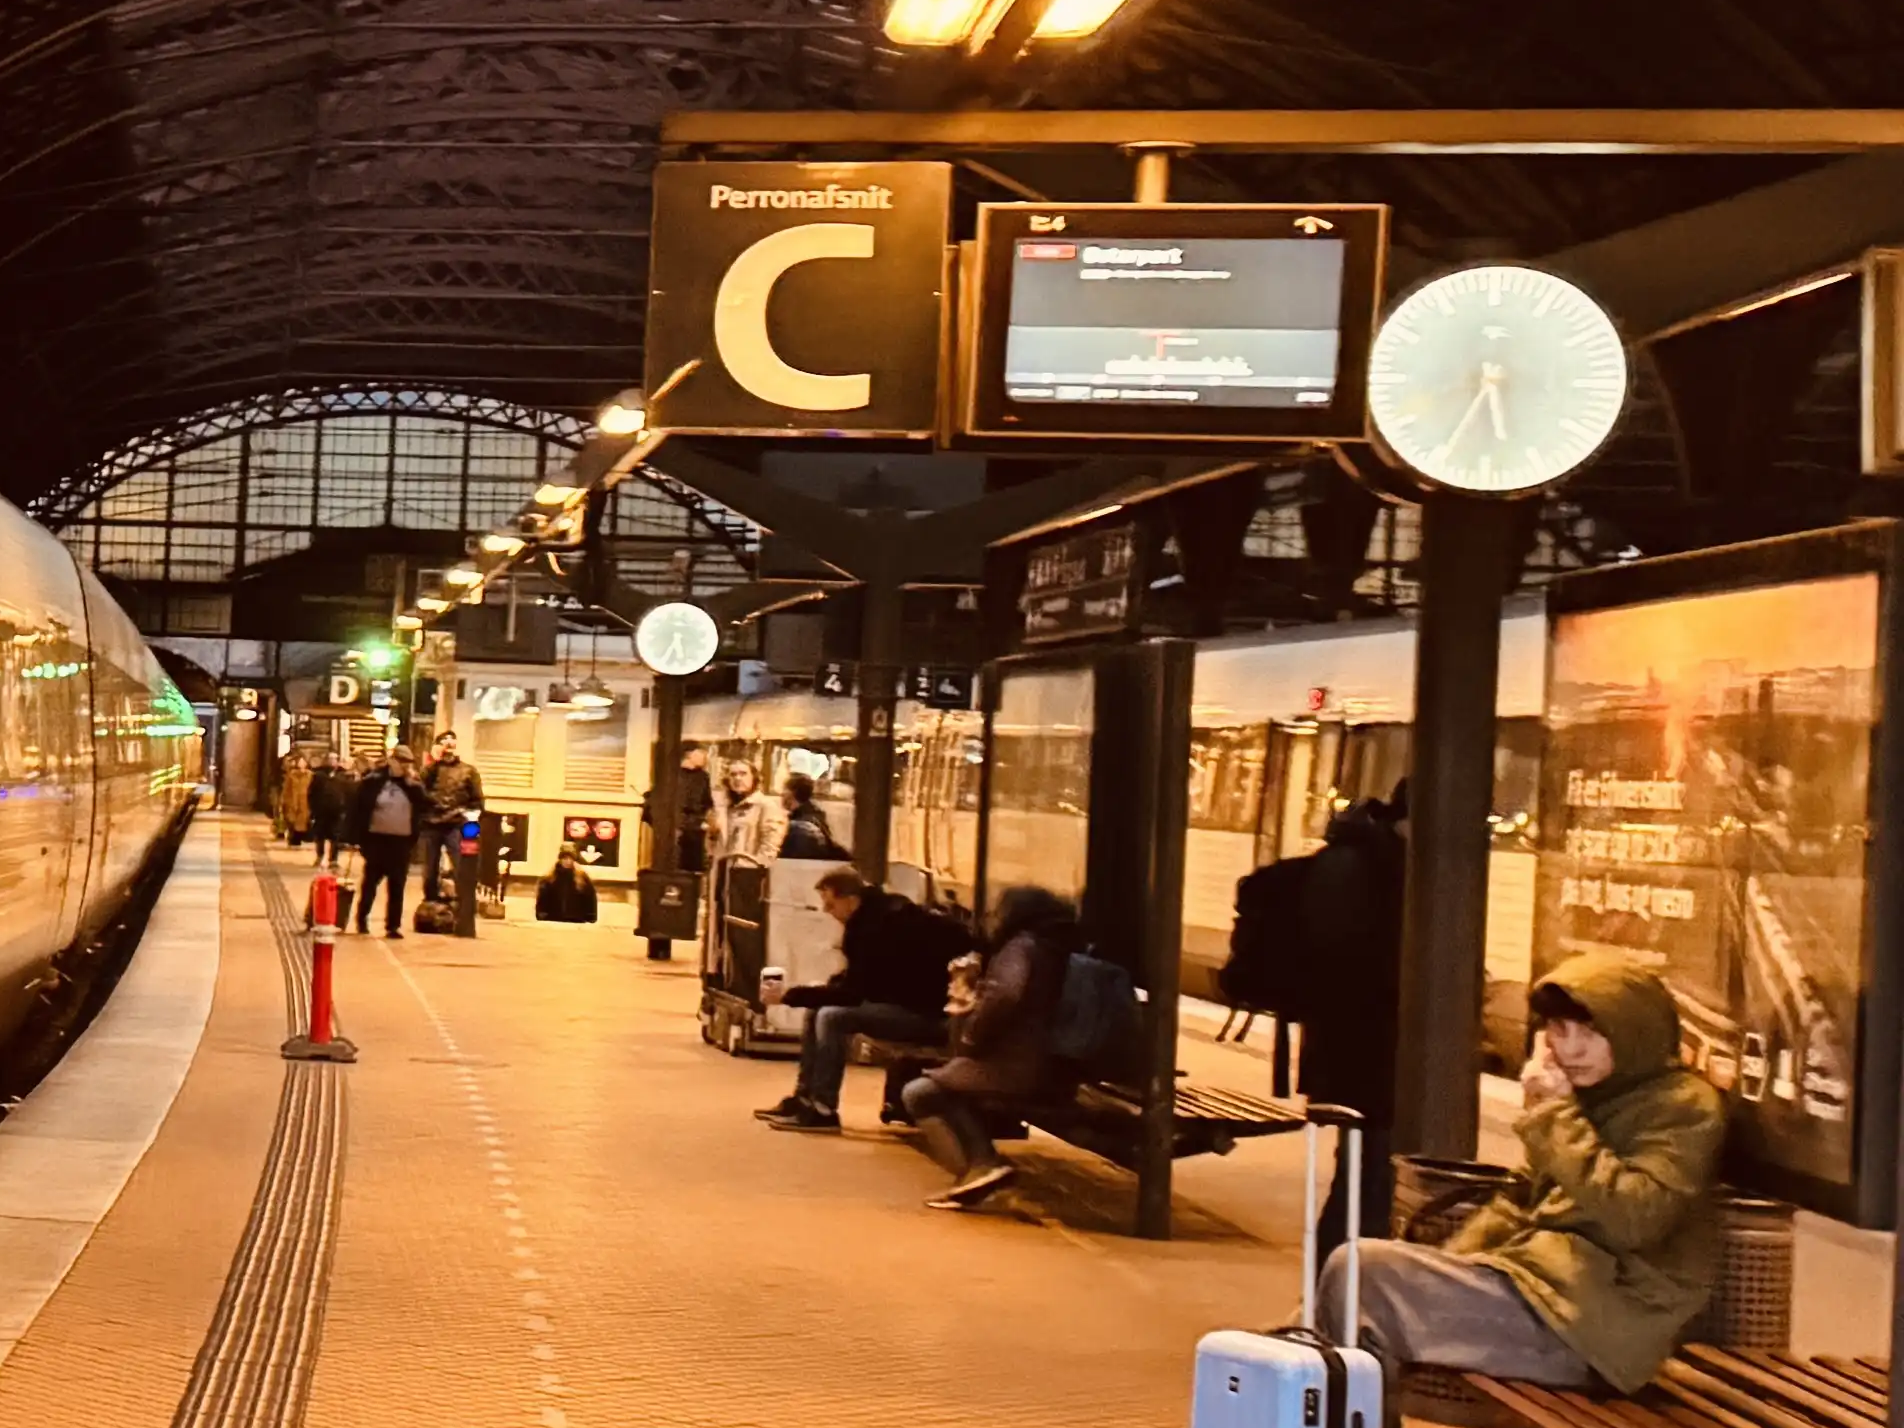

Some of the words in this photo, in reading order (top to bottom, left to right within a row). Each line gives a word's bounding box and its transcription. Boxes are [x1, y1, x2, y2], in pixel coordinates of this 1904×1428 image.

[710, 184, 894, 210] Perronafsnit
[714, 222, 876, 411] C
[329, 675, 360, 704] D
